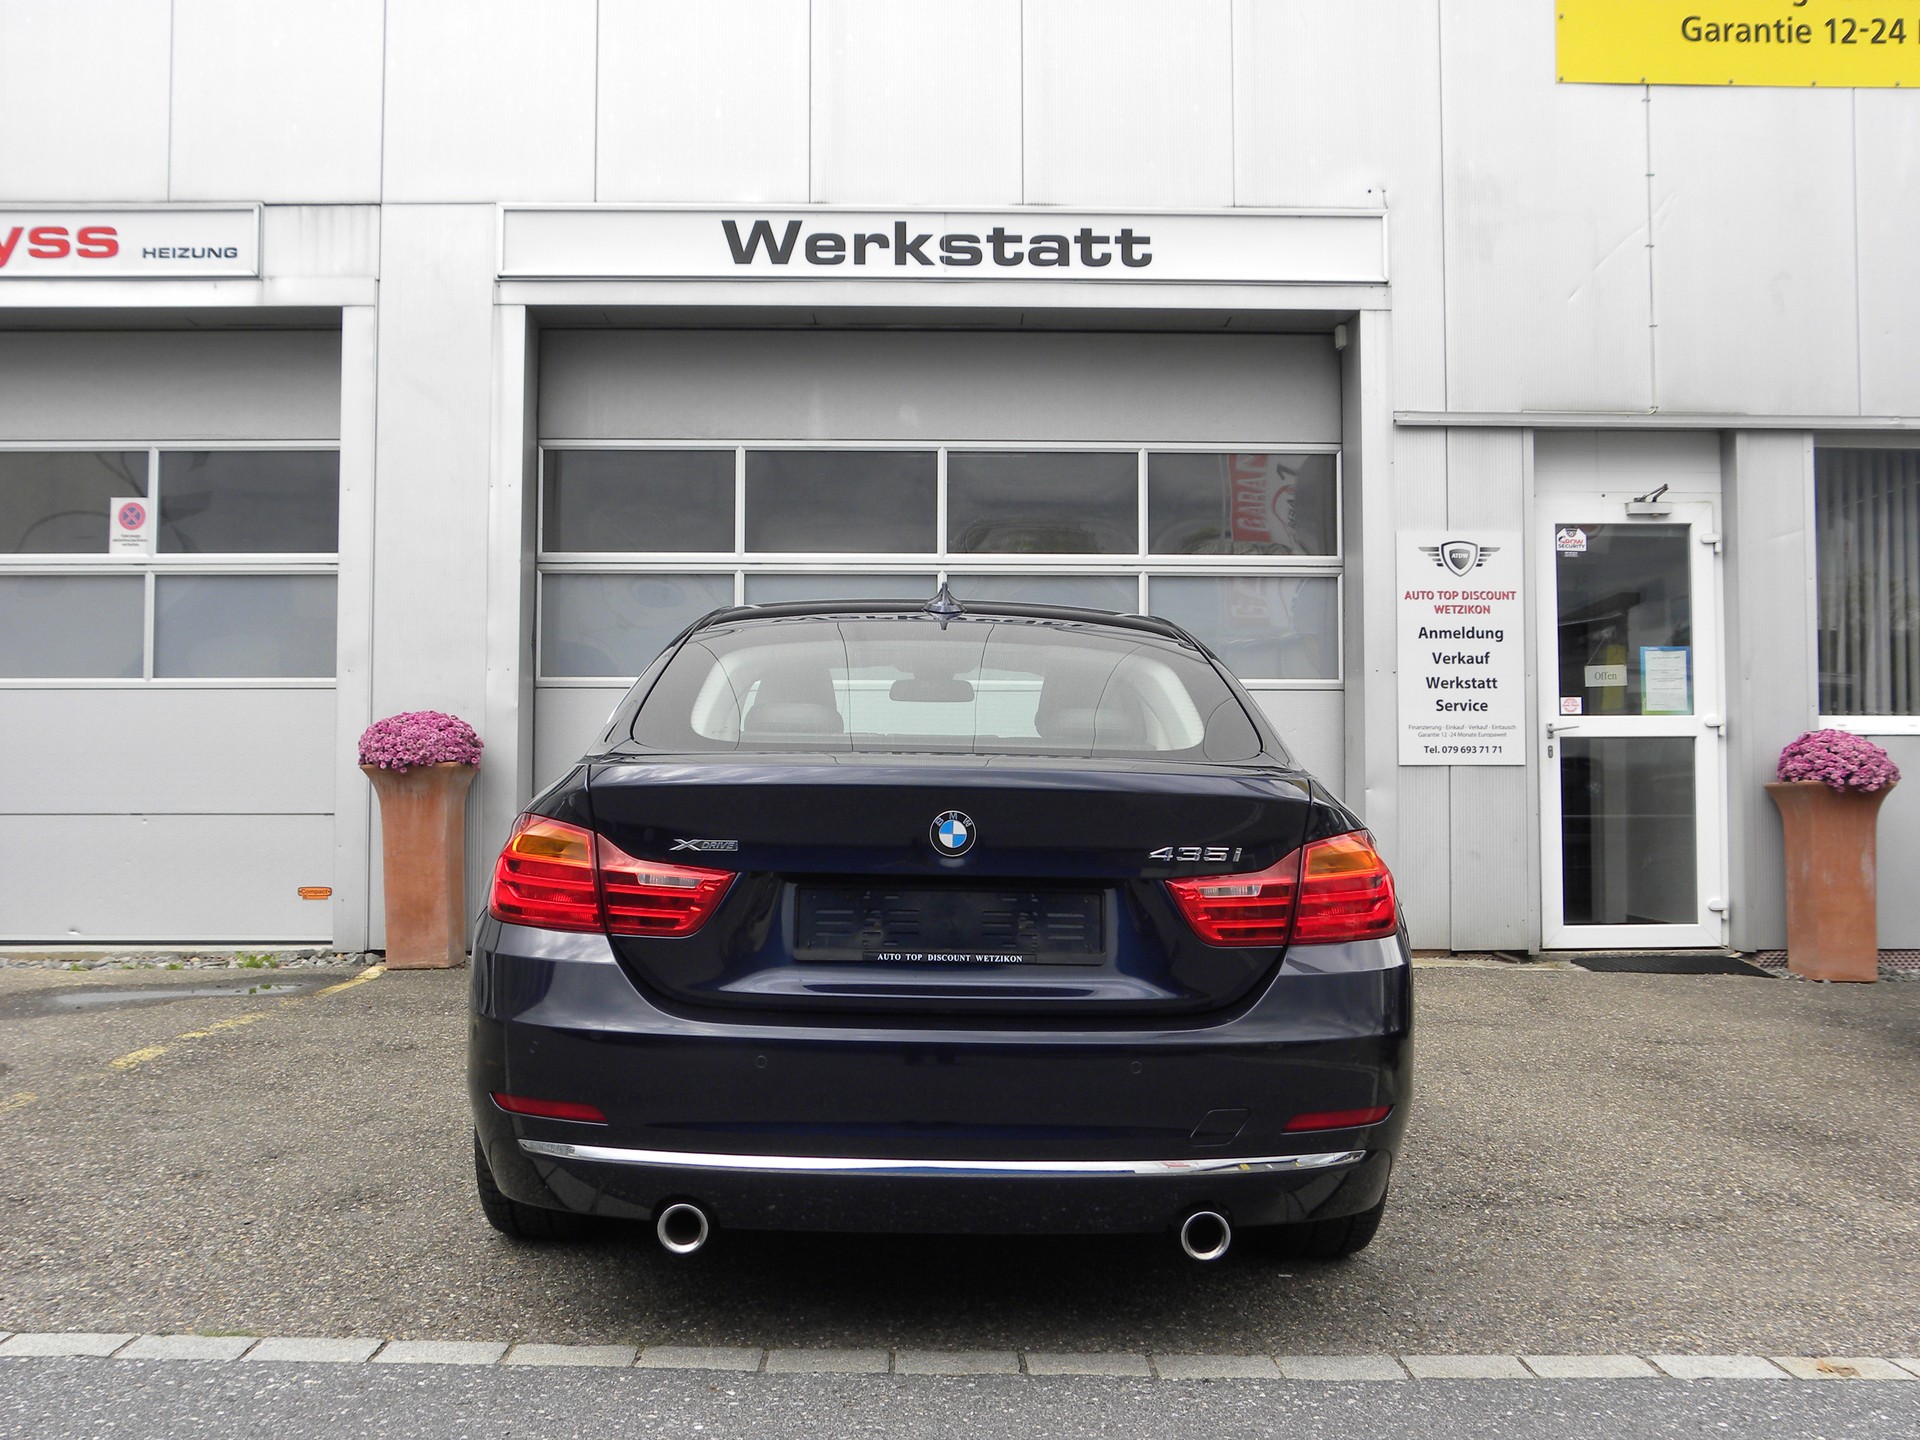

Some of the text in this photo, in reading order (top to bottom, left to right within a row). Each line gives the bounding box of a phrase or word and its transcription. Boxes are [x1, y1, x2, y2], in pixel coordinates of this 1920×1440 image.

[1681, 15, 1812, 44] Garantie
[1824, 17, 1907, 45] 12-24
[721, 219, 1153, 268] Werkstatt
[142, 247, 238, 259] HEIZUNG
[1404, 590, 1517, 600] AUTO TOP DISCOUNT
[1434, 604, 1491, 614] WETZIKON
[1418, 626, 1504, 642] Anmeldung
[1432, 652, 1491, 664] Verkauf
[1594, 671, 1617, 681] Offen
[1425, 676, 1498, 689] Werkstatt
[1436, 699, 1488, 712] Service
[1424, 745, 1503, 754] Tel. 079 693 71 71
[934, 812, 972, 828] BMW
[1148, 846, 1243, 862] 435i
[877, 953, 1023, 963] AUTO TOP DISCOUNT WETZIKON
